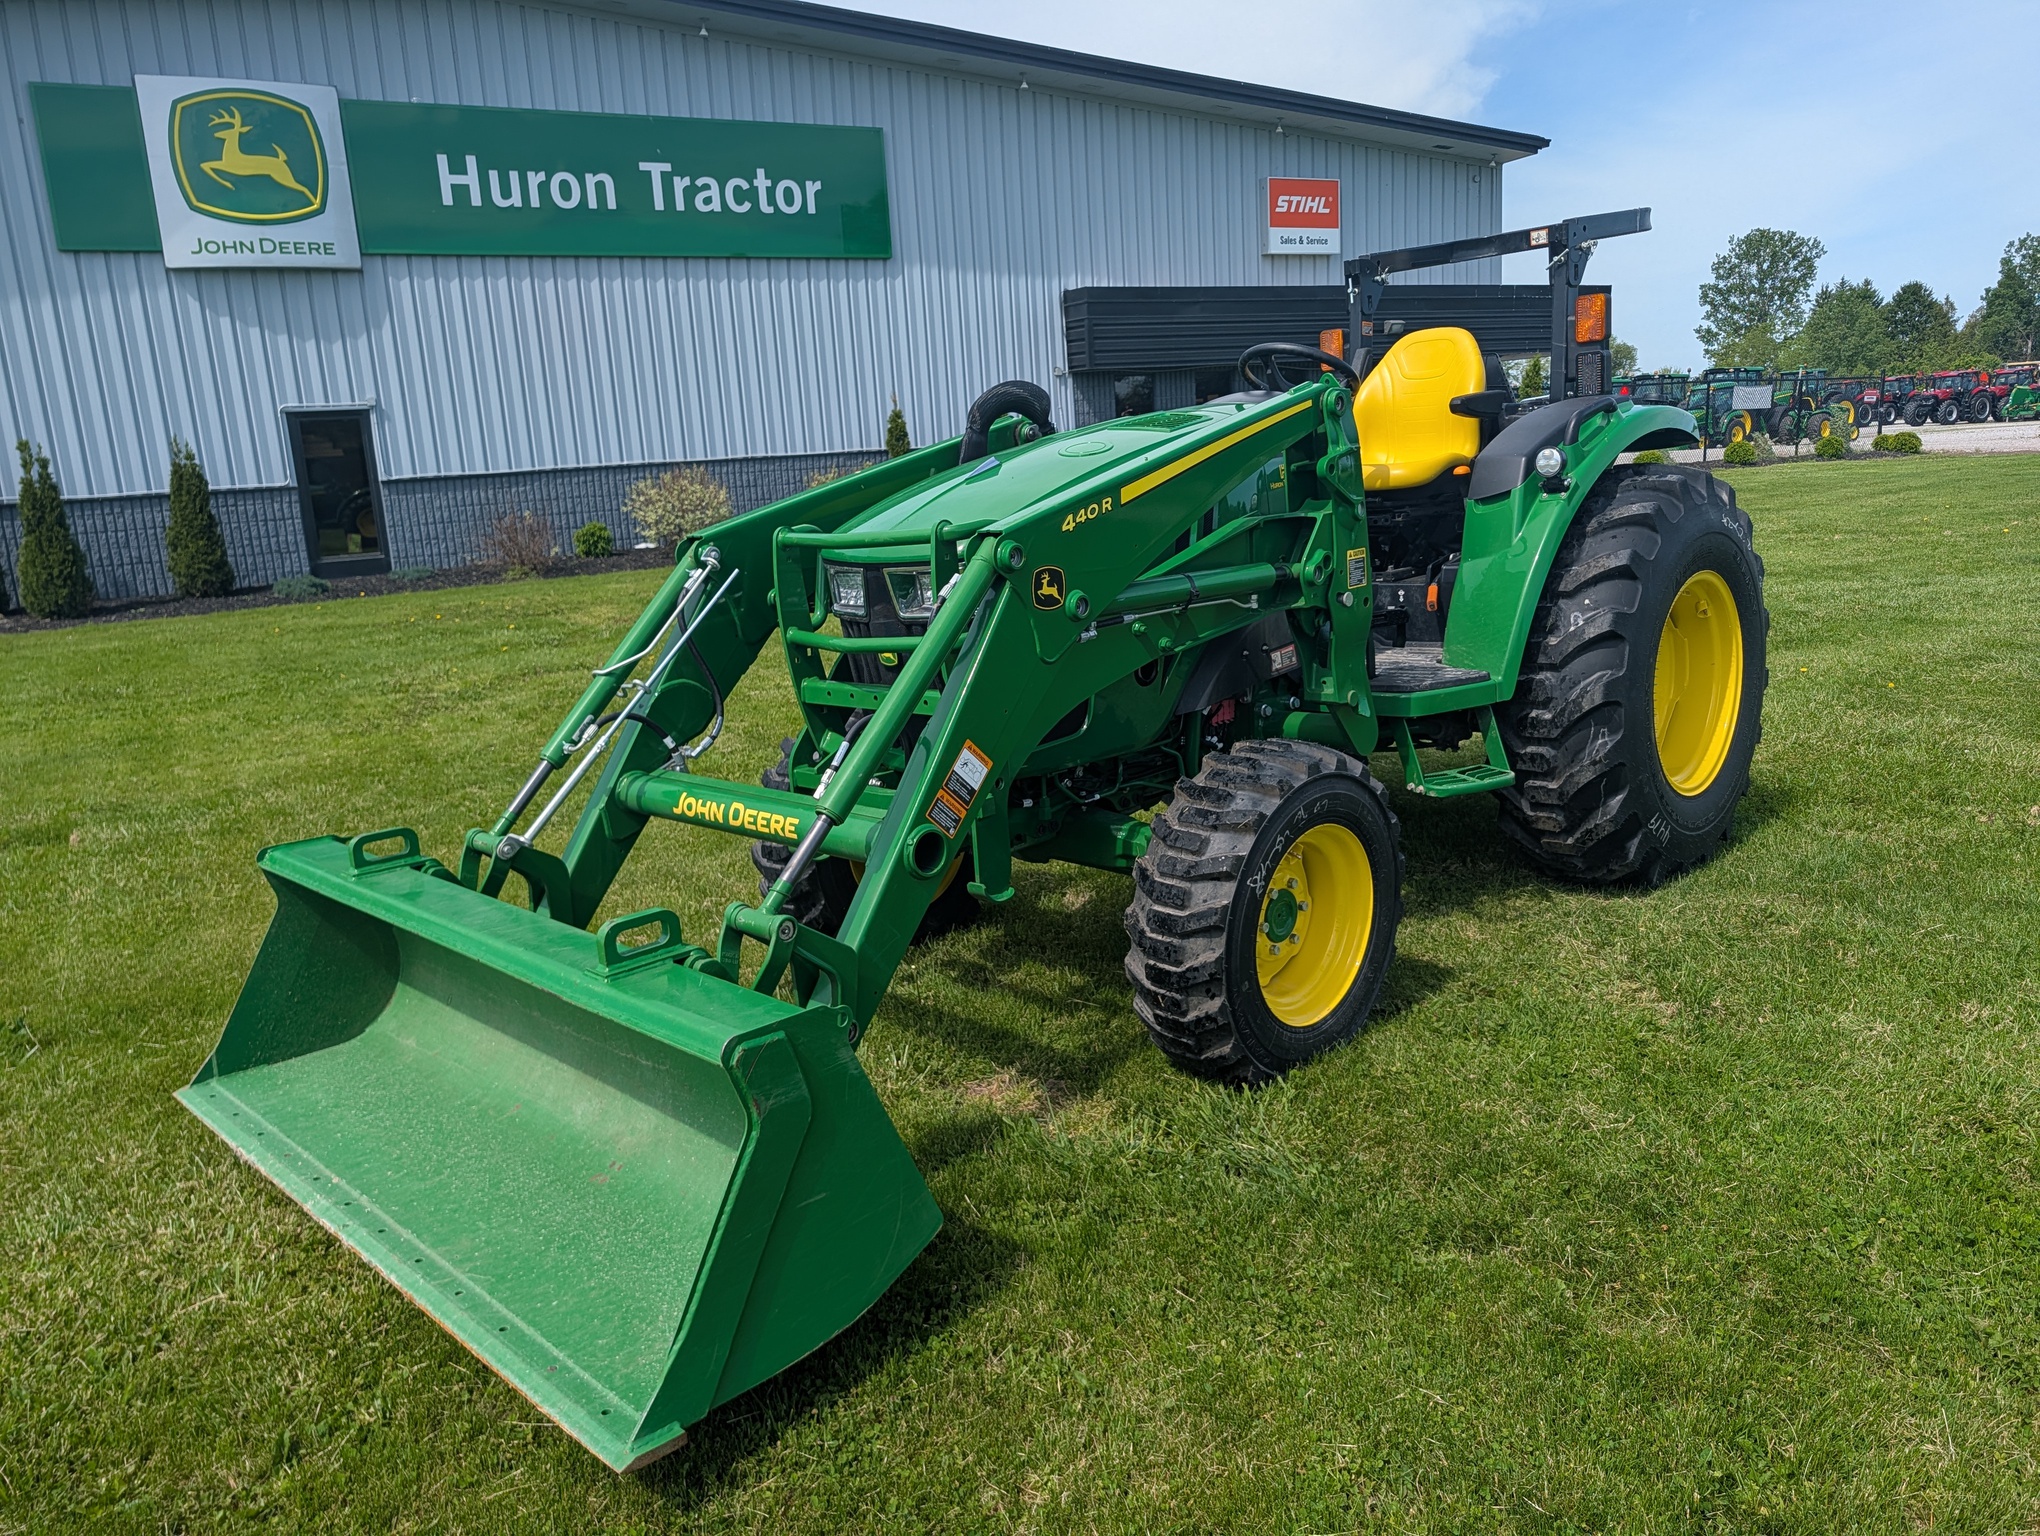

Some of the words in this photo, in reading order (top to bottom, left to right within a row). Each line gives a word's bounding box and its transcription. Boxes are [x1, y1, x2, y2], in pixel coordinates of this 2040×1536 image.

[436, 153, 617, 210] Huron
[638, 161, 822, 215] Tractor
[1275, 195, 1330, 214] STIHL
[190, 237, 255, 255] JOHN
[258, 237, 337, 256] DEERE
[1280, 235, 1297, 245] Sales
[1298, 235, 1304, 245] &
[1306, 236, 1328, 245] Service
[672, 791, 726, 824] JOHN
[728, 801, 800, 839] DEERE
